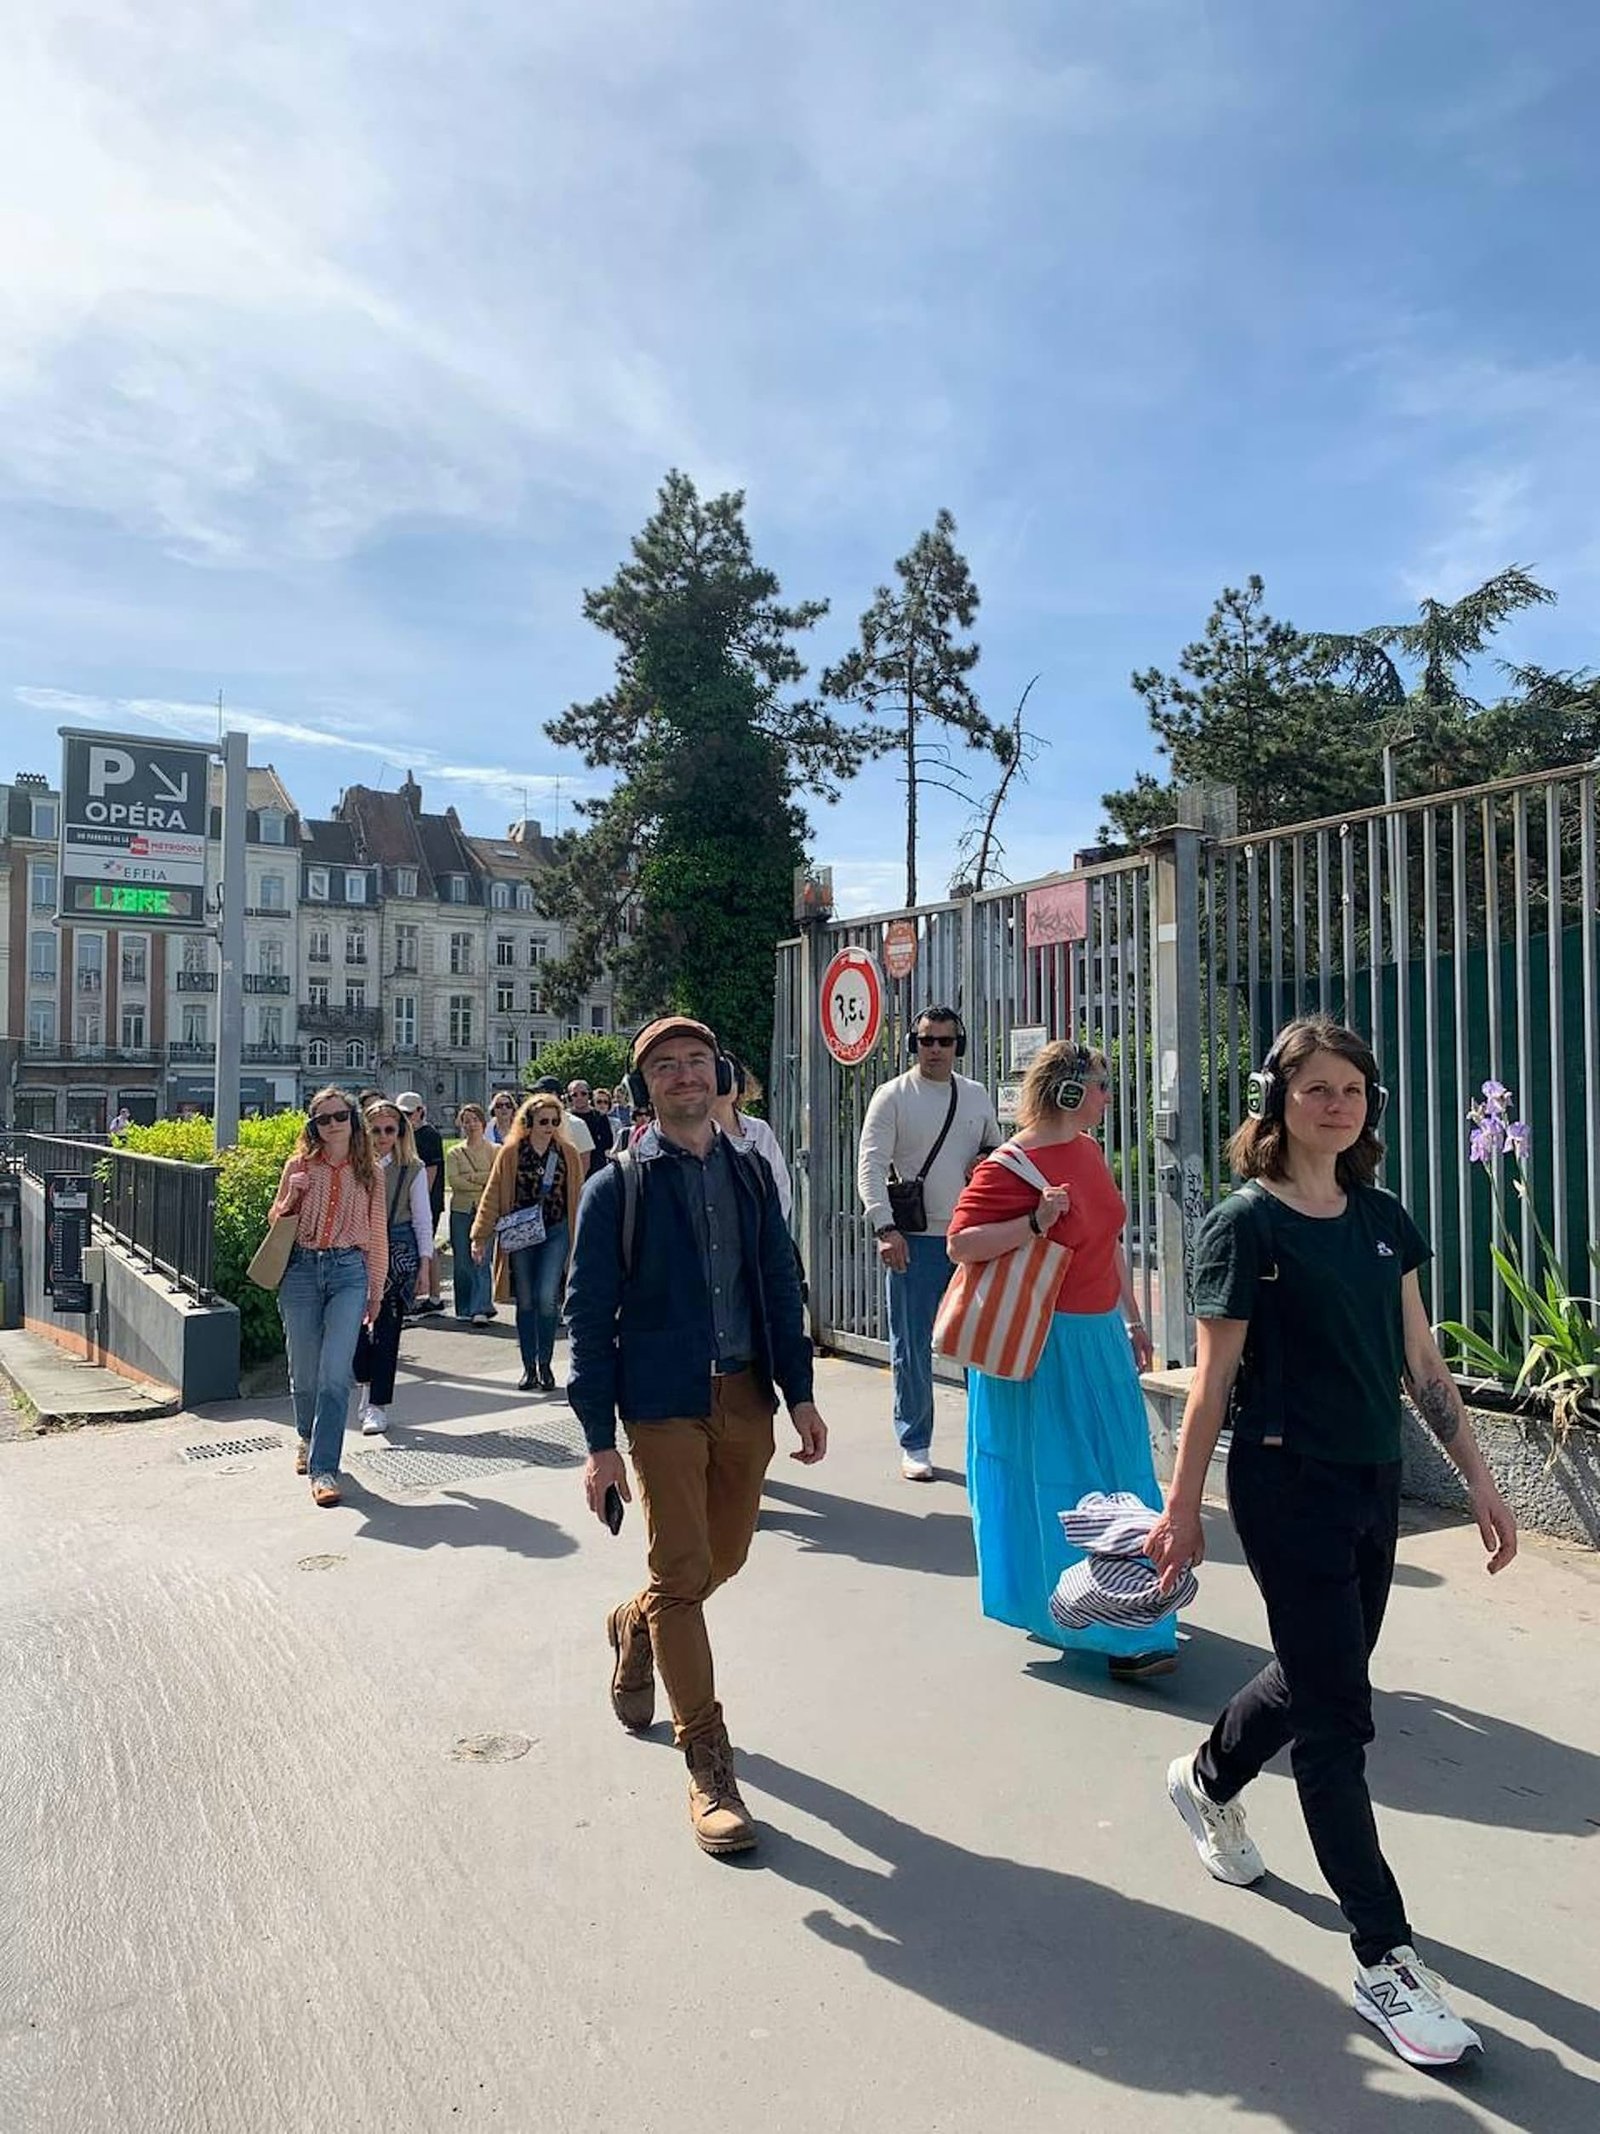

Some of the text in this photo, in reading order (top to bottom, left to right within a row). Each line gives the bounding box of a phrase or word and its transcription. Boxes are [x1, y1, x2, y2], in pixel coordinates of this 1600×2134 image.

[89, 746, 136, 797] P
[85, 802, 187, 830] OPÉRA
[124, 867, 167, 881] EFFIA
[94, 885, 171, 914] LIBRE
